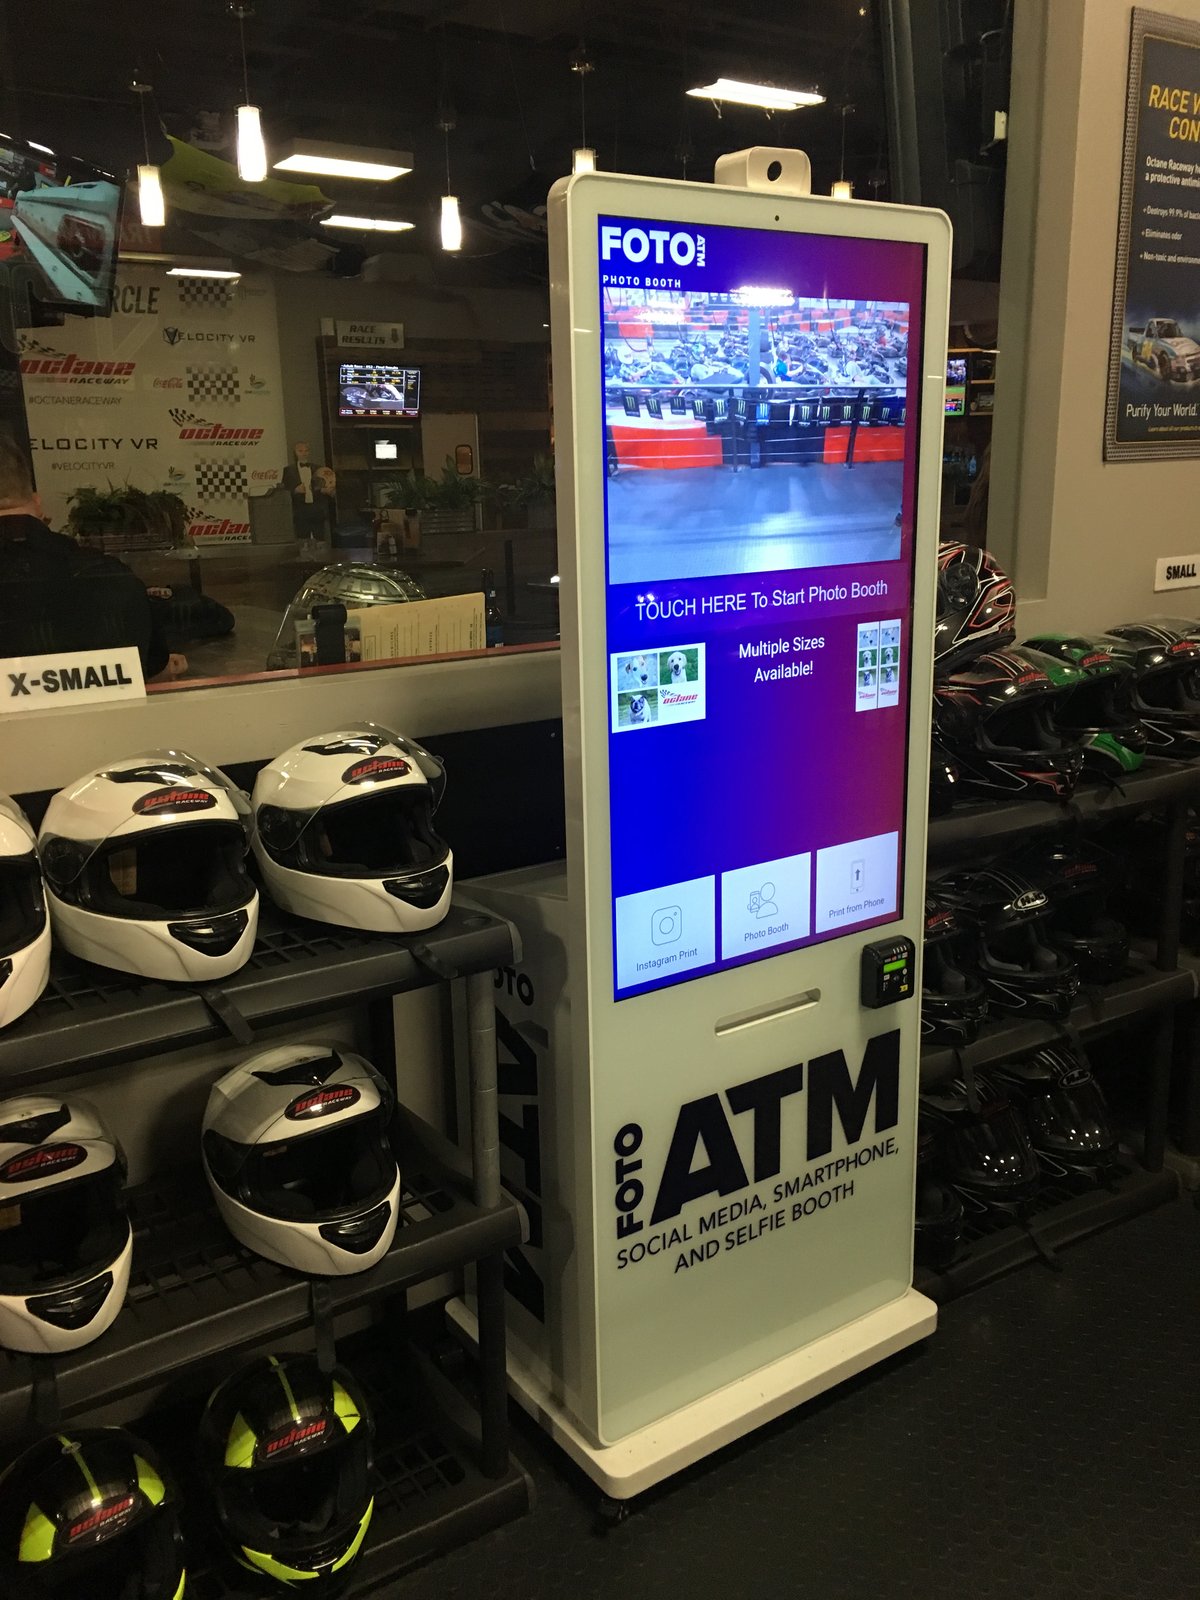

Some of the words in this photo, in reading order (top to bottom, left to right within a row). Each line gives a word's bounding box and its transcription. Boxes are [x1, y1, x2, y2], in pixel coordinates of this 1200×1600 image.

[1149, 85, 1190, 113] RACE
[1146, 155, 1168, 169] Octane
[1168, 159, 1195, 175] Raceway
[602, 226, 696, 266] FOTO
[697, 234, 705, 267] ATM
[603, 275, 640, 286] PHOTO
[645, 278, 681, 288] BOOTH
[113, 285, 160, 313] RCLE
[350, 325, 376, 333] RACE
[29, 395, 122, 405] #OCTANERACEWAY
[1126, 403, 1151, 420] Purify
[1153, 403, 1172, 417] Your
[179, 424, 264, 439] octane
[29, 438, 123, 450] ELOCITY
[130, 438, 158, 450] VR
[51, 462, 115, 471] #VELOCITYVR
[1166, 563, 1197, 580] SMALL
[635, 599, 696, 621] TOUCH
[701, 594, 746, 614] HERE
[751, 592, 768, 609] To
[772, 587, 805, 606] Start
[808, 584, 848, 602] Photo
[851, 580, 888, 598] Booth
[739, 641, 790, 659] Multiple
[793, 636, 825, 651] Sizes
[8, 663, 132, 697] X-SMALL
[754, 661, 813, 683] Available!
[829, 907, 845, 918] Print
[846, 904, 863, 914] from
[863, 897, 885, 909] Phone
[744, 930, 766, 942] Photo
[767, 922, 789, 936] Booth
[636, 954, 677, 971] Instagram
[679, 948, 698, 959] Print
[649, 1028, 900, 1226] ATM
[614, 1123, 644, 1239] FOTO
[617, 1223, 693, 1269] SOCIAL
[700, 1194, 767, 1234] MEDIA,
[773, 1137, 899, 1203] SMARTPHONE,
[674, 1240, 720, 1273] AND
[725, 1210, 786, 1251] SELFIE
[792, 1180, 855, 1222] BOOTH
